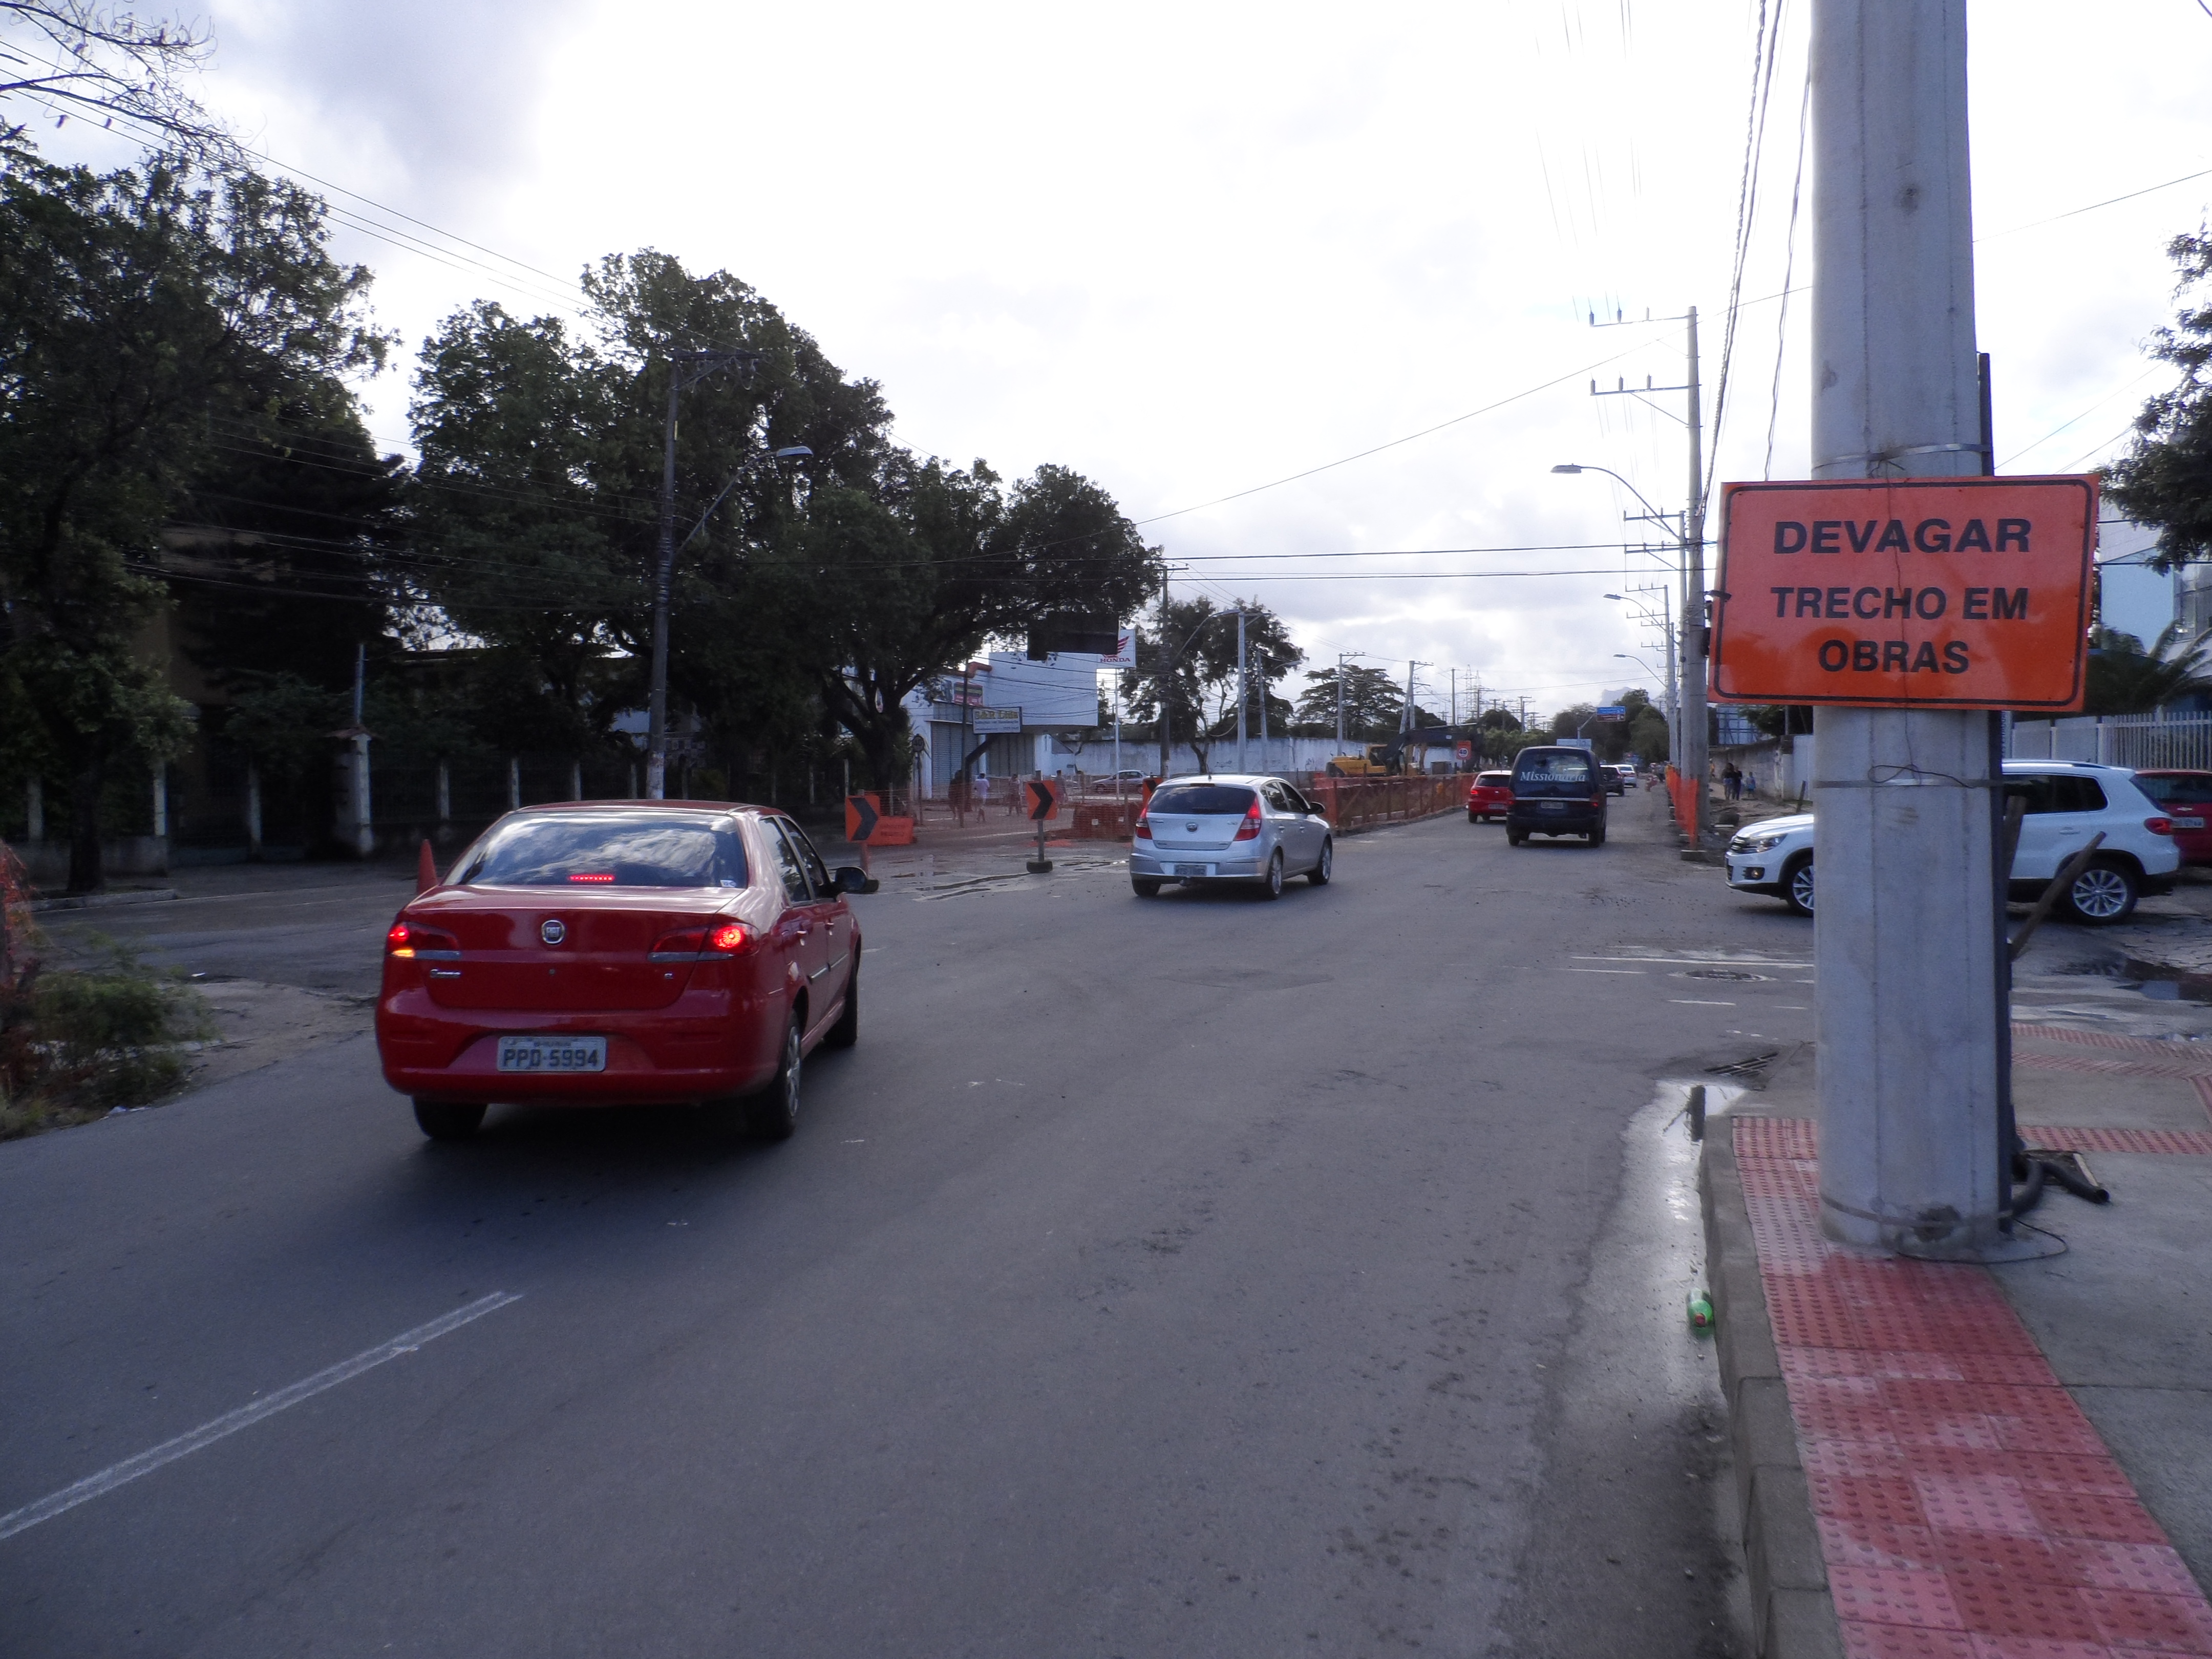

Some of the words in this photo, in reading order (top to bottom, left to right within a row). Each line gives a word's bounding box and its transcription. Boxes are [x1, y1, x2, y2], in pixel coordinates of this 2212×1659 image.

[1774, 518, 2032, 555] DEVAGAR
[1770, 587, 1946, 620] TRECHO
[1962, 587, 2029, 620] EM
[1818, 640, 1970, 675] OBRAS
